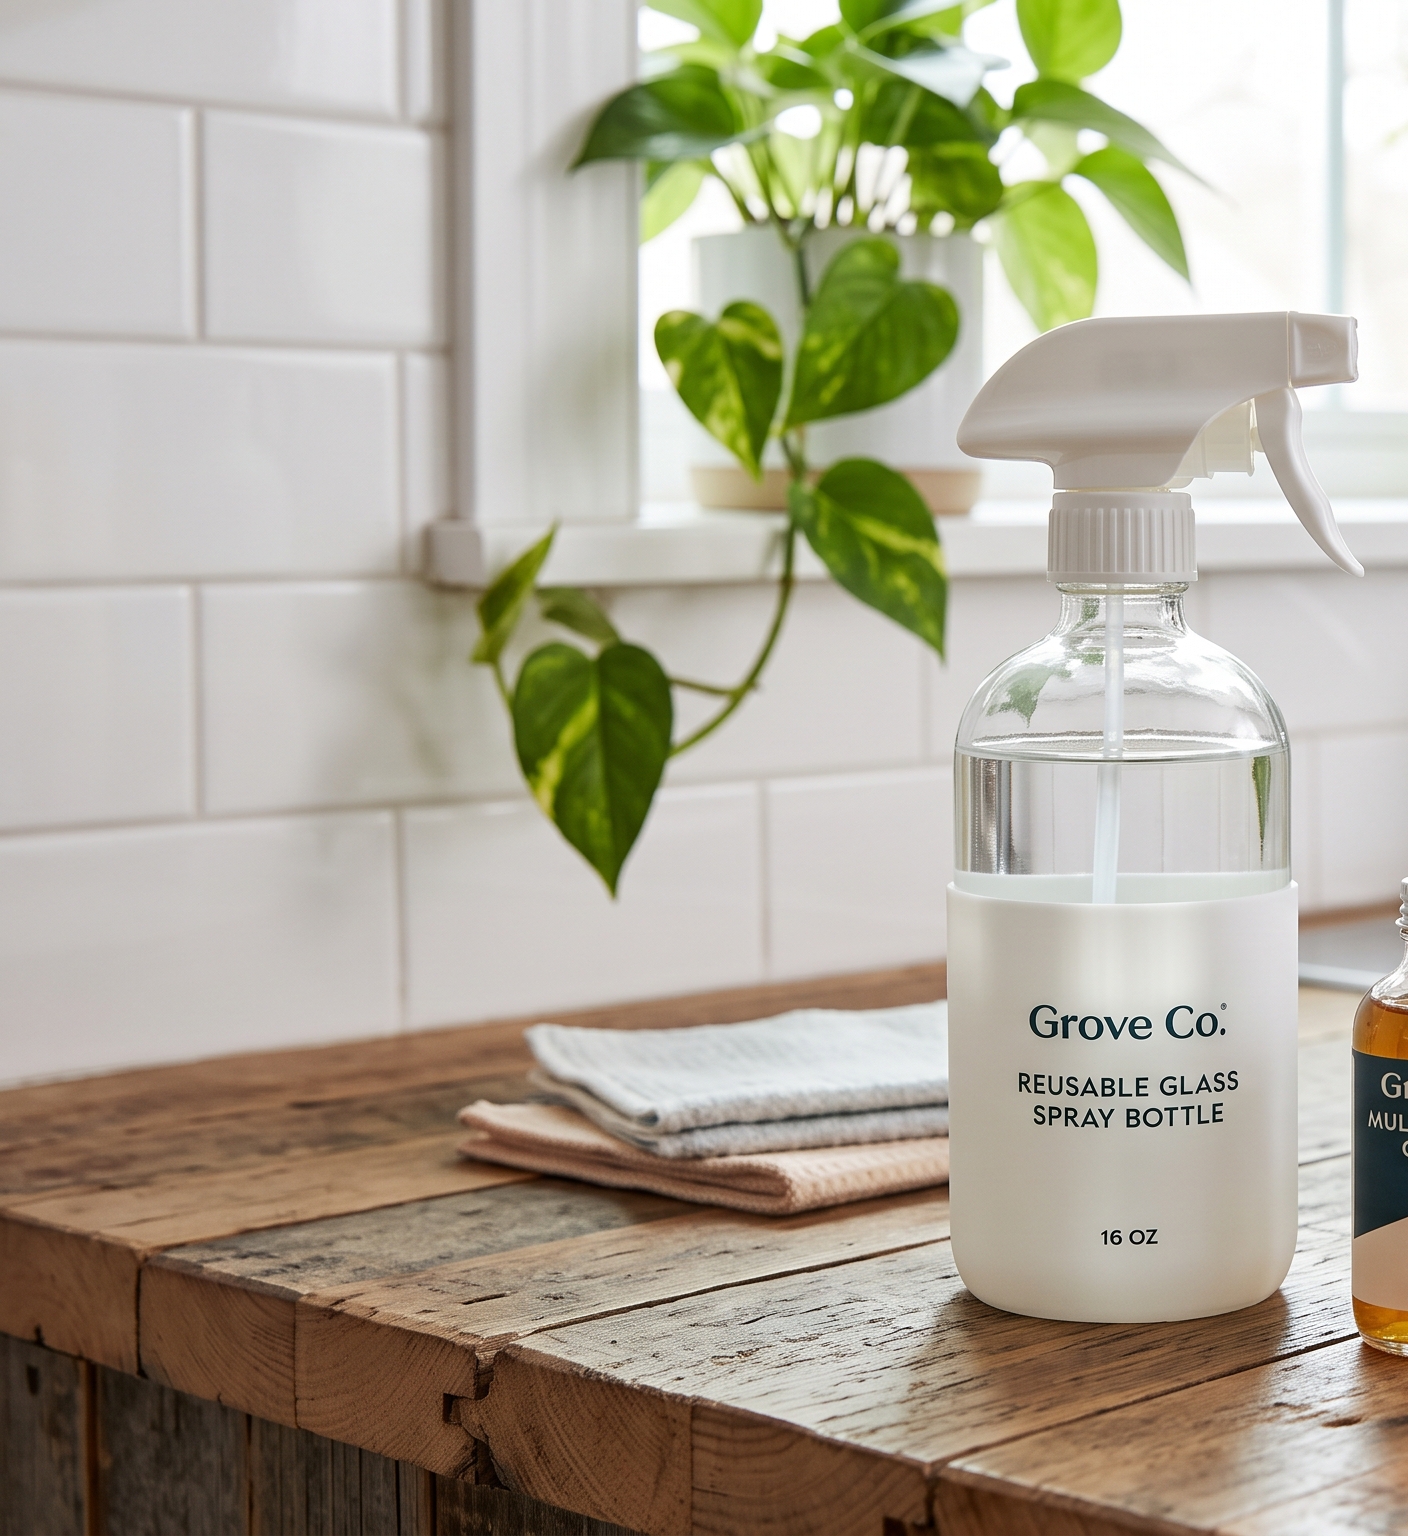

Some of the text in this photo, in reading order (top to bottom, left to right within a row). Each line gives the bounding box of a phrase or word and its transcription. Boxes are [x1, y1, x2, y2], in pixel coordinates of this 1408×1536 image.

[1029, 1004, 1153, 1041] Grove
[1018, 1070, 1239, 1098] REUSABLE GLASS
[1033, 1102, 1224, 1129] SPRAY BOTTLE
[1100, 1228, 1159, 1246] 16 OZ
